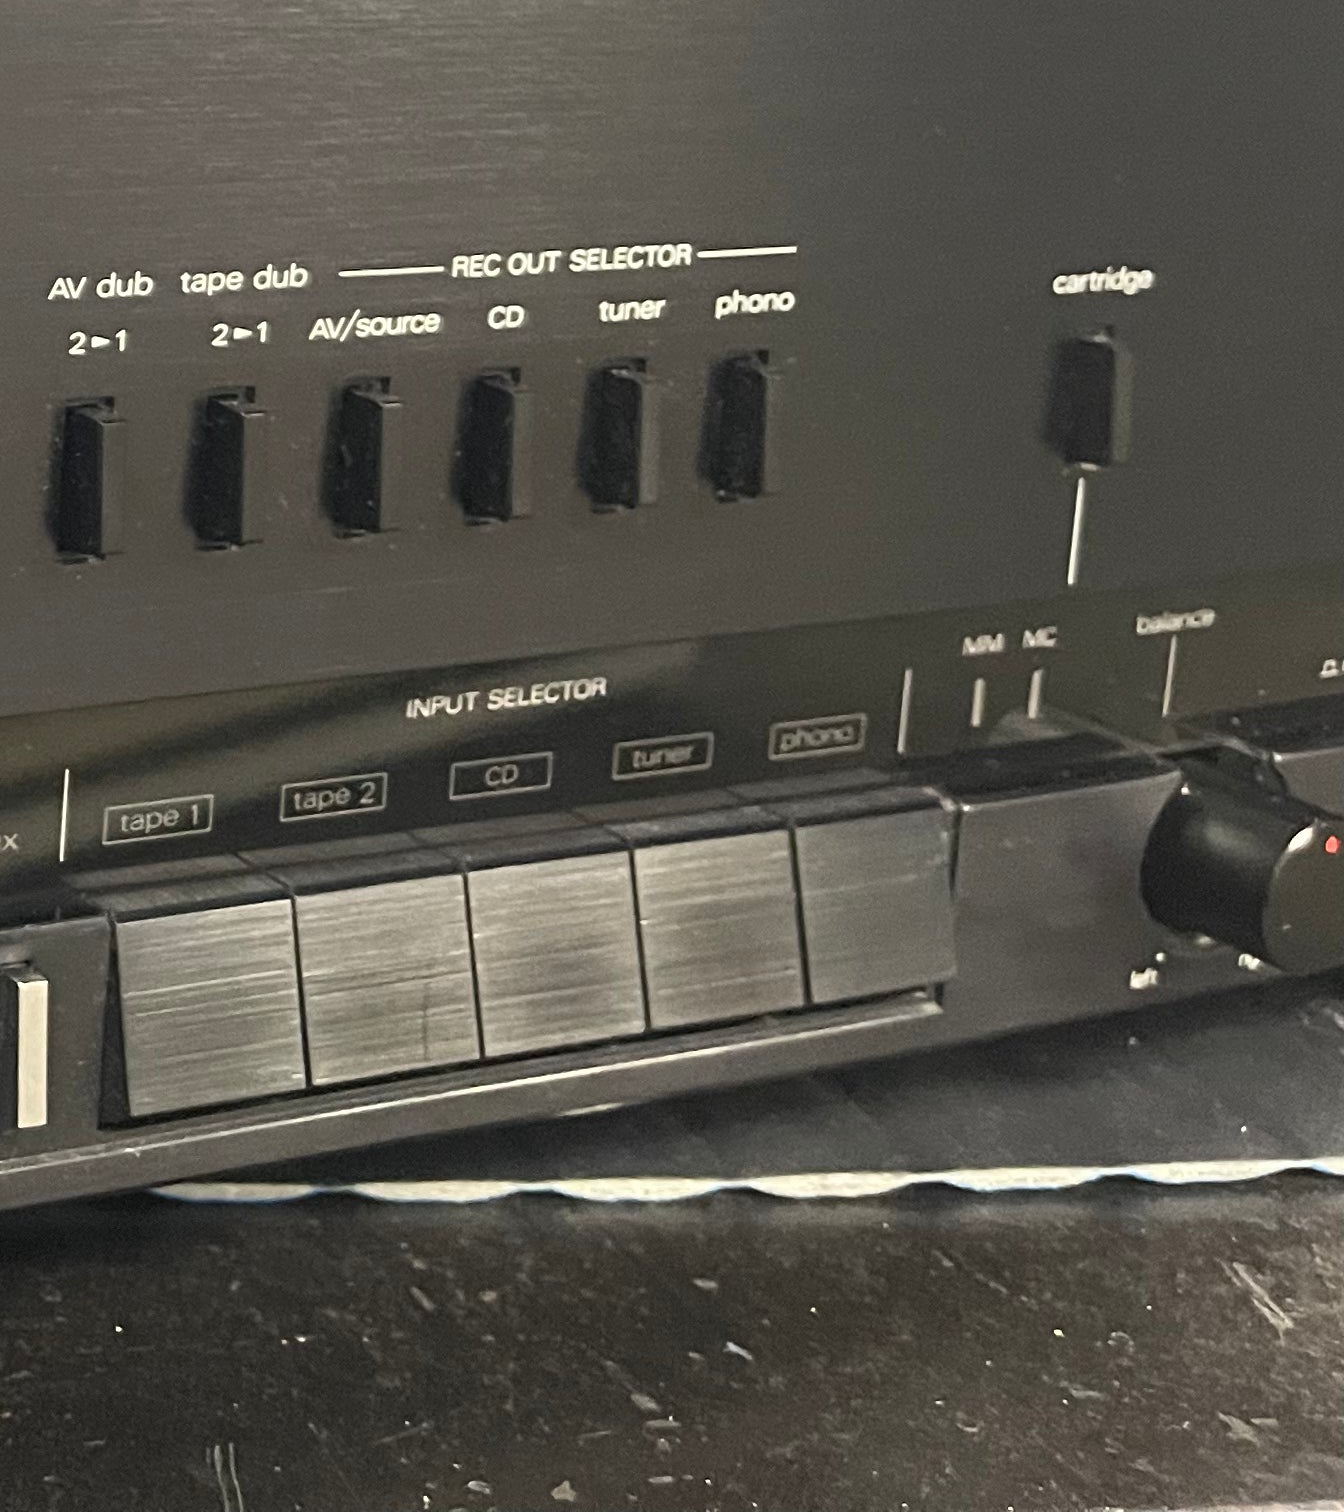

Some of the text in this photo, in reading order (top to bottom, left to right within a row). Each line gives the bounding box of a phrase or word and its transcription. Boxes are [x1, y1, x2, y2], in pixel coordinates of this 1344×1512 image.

[450, 243, 693, 280] REC OUT SELECTOR
[47, 270, 154, 300] AV dub
[180, 262, 309, 297] tape dub
[1052, 265, 1157, 296] cartridge
[487, 304, 525, 330] CD
[598, 297, 667, 323] tuner
[715, 287, 796, 320] phono
[308, 308, 443, 343] AV/source
[406, 677, 608, 720] INPUT SELECTOR
[485, 765, 519, 788] CD
[293, 782, 376, 812] tape 2
[120, 805, 200, 835] tape 1
